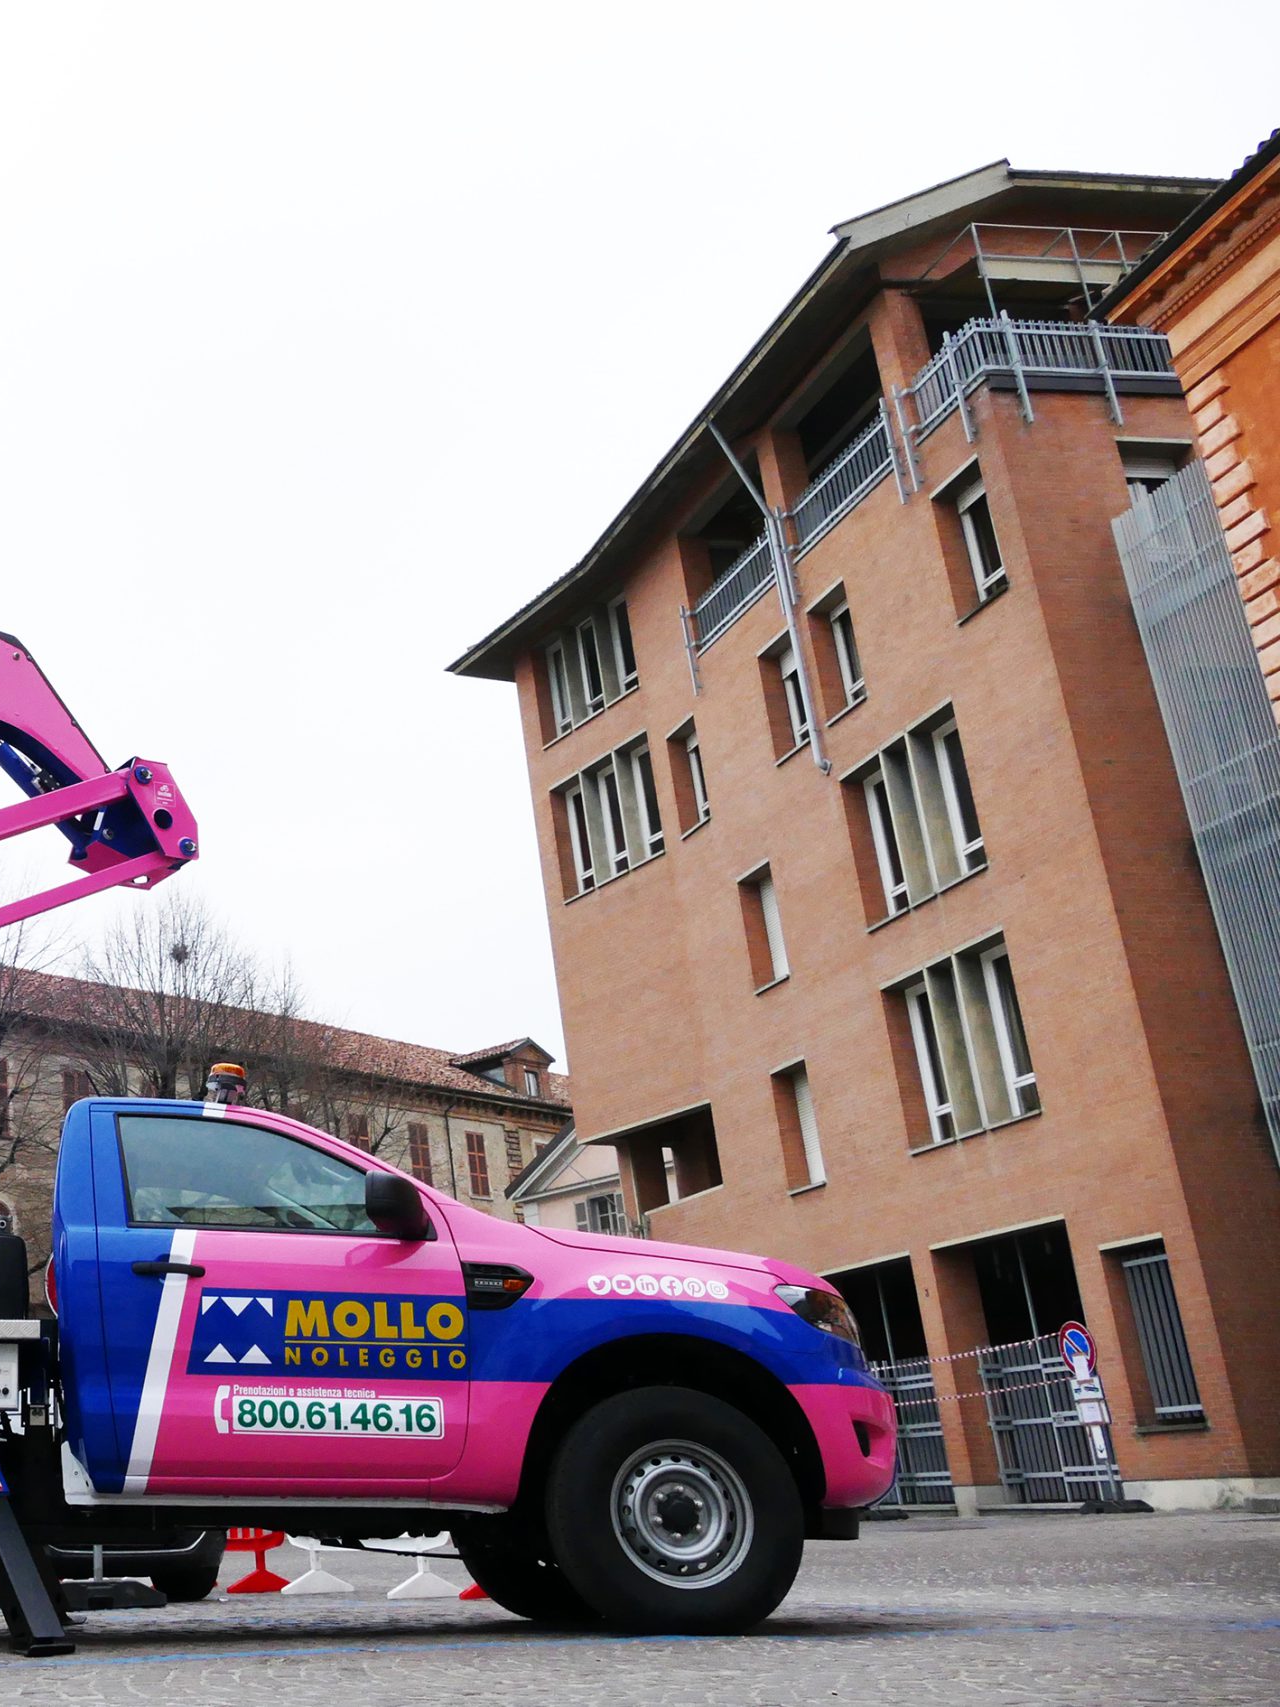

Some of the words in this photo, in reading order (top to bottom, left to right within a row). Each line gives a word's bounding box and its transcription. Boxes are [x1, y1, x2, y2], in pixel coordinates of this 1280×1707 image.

[284, 1299, 465, 1340] MOLLO
[284, 1346, 467, 1369] NOLEGGIO
[233, 1384, 287, 1397] Prenotazioni
[289, 1388, 295, 1397] e
[296, 1385, 343, 1398] assistenza
[344, 1387, 376, 1399] tecnica
[237, 1399, 436, 1433] 800.61.46.16
